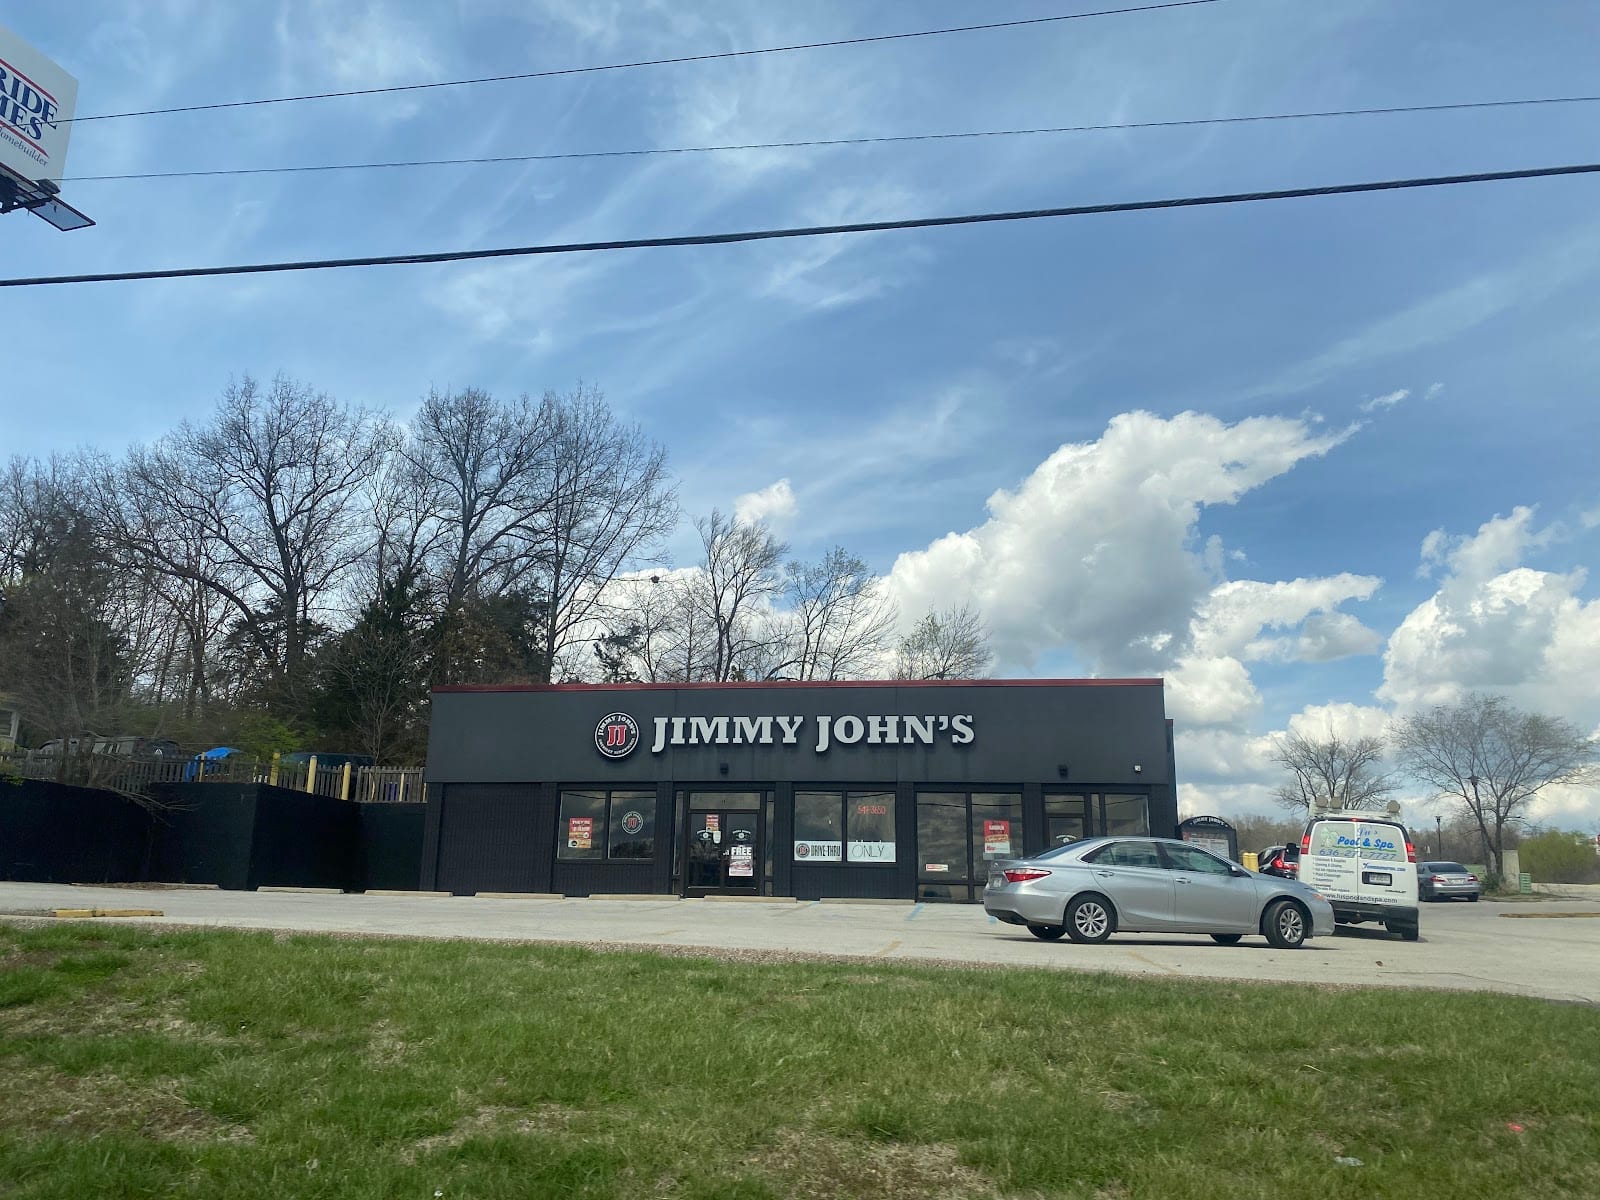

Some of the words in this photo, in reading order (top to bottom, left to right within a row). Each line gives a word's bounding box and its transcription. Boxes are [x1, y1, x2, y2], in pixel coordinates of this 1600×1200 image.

[598, 716, 616, 736] JIMMY
[652, 716, 804, 752] JIMMY
[815, 714, 975, 752] JOHN'S
[606, 725, 627, 746] JJ
[731, 847, 752, 856] FREE
[852, 845, 885, 858] ONLY
[1337, 836, 1361, 846] Pool
[1362, 837, 1372, 847] &
[1373, 838, 1395, 850] Spa
